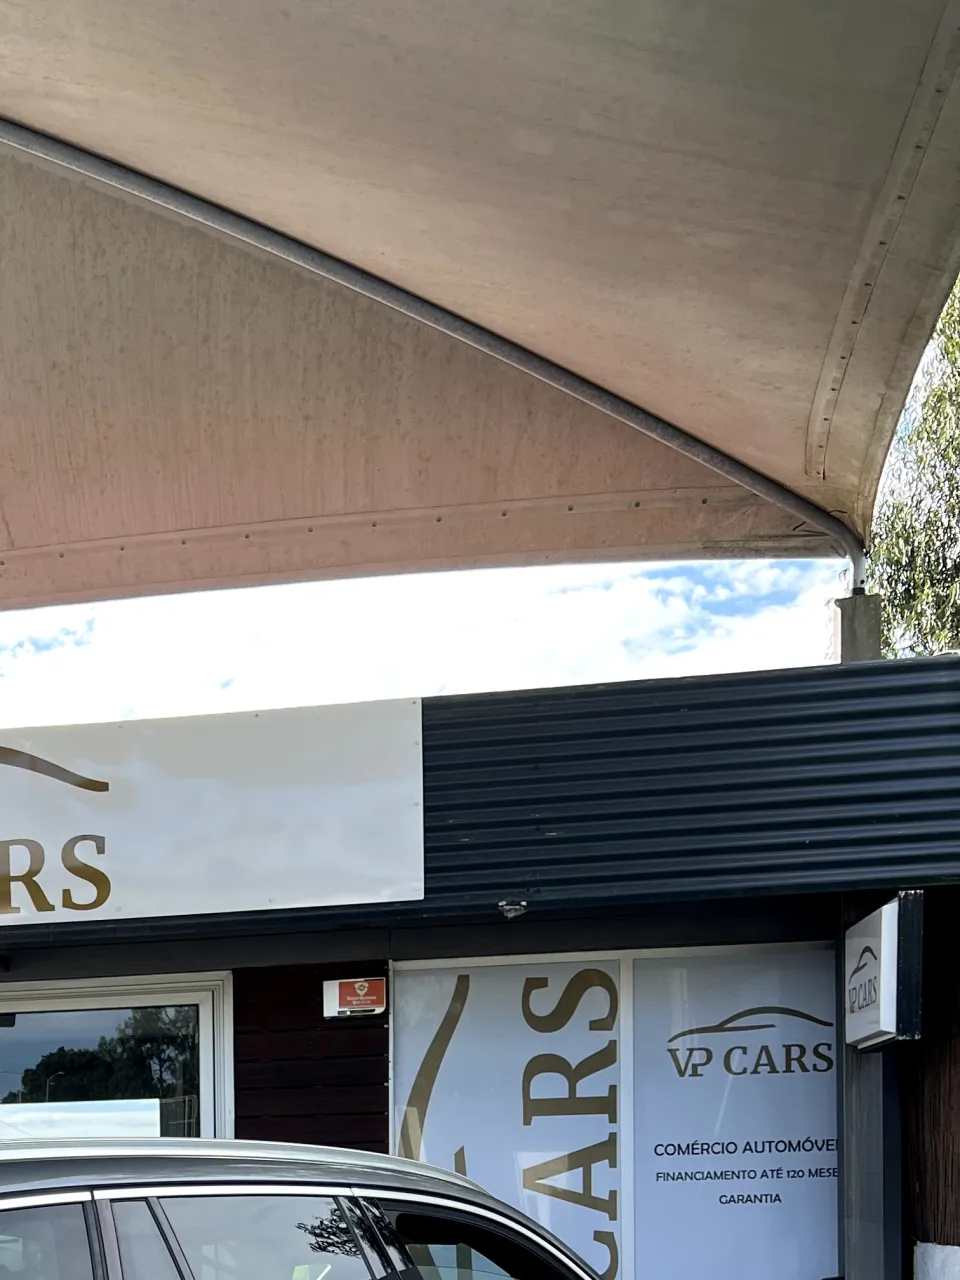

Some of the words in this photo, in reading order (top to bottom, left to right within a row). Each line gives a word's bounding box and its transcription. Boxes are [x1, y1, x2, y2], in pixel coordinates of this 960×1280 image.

[848, 986, 858, 1014] VP
[857, 975, 878, 1011] CARS
[667, 1047, 713, 1078] VP
[723, 1043, 834, 1076] CARS
[653, 1139, 738, 1157] COMÉRCIO
[656, 1169, 758, 1182] FINANCIAMENTO
[760, 1167, 784, 1180] ATÉ
[786, 1169, 805, 1180] 120
[719, 1193, 782, 1205] GARANTIA
